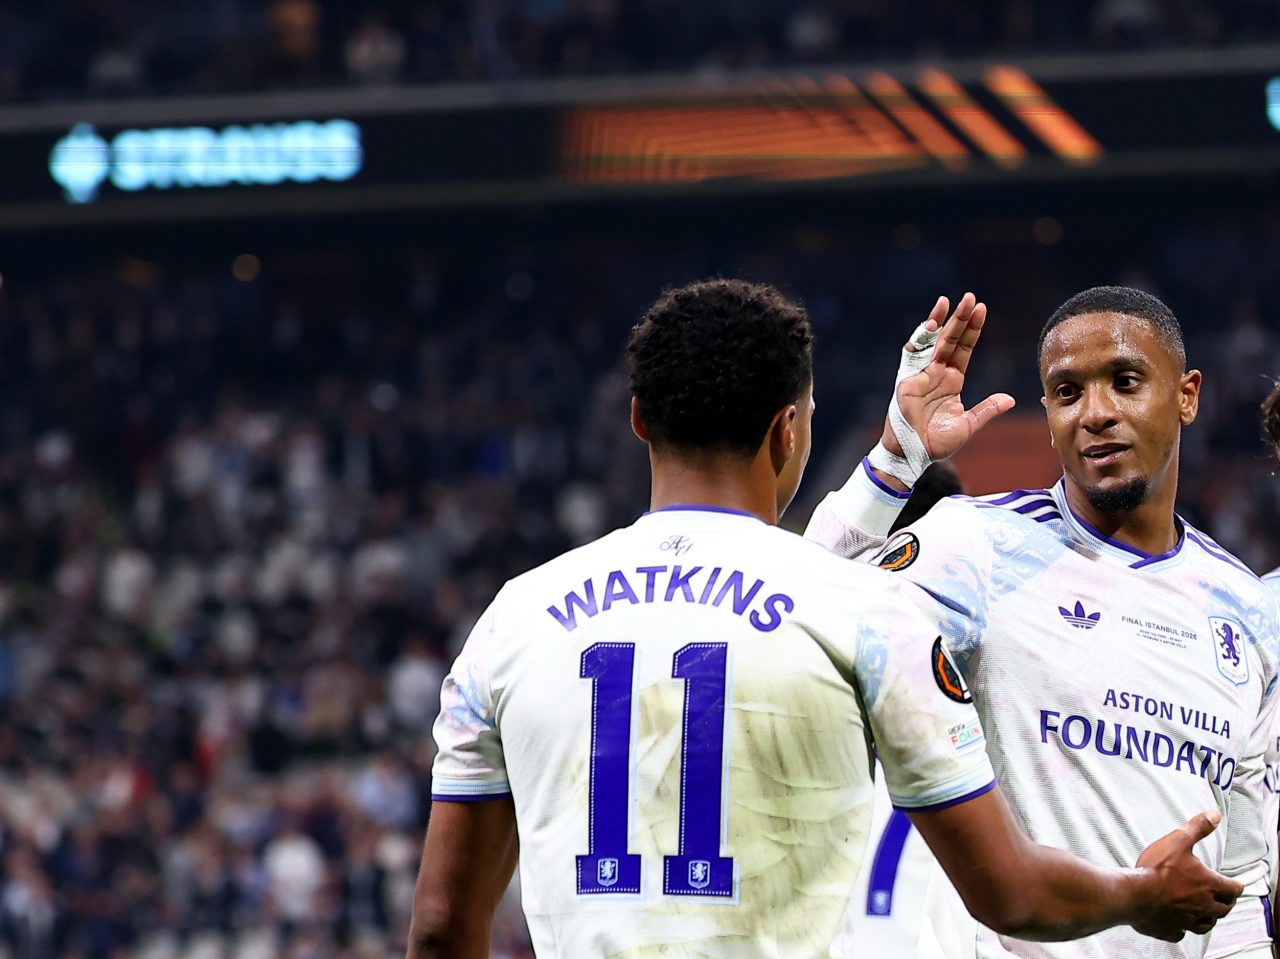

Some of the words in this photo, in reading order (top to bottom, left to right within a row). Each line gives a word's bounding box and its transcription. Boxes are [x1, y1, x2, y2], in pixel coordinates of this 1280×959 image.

[546, 564, 795, 632] WATKINS
[1121, 615, 1144, 627] FINAL
[1145, 621, 1180, 636] ISTANBUL
[1181, 629, 1198, 641] 2026
[1103, 688, 1174, 721] ASTON
[1179, 706, 1231, 739] VILLA
[575, 641, 735, 898] 11
[1039, 709, 1236, 791] FOUNDATIO
